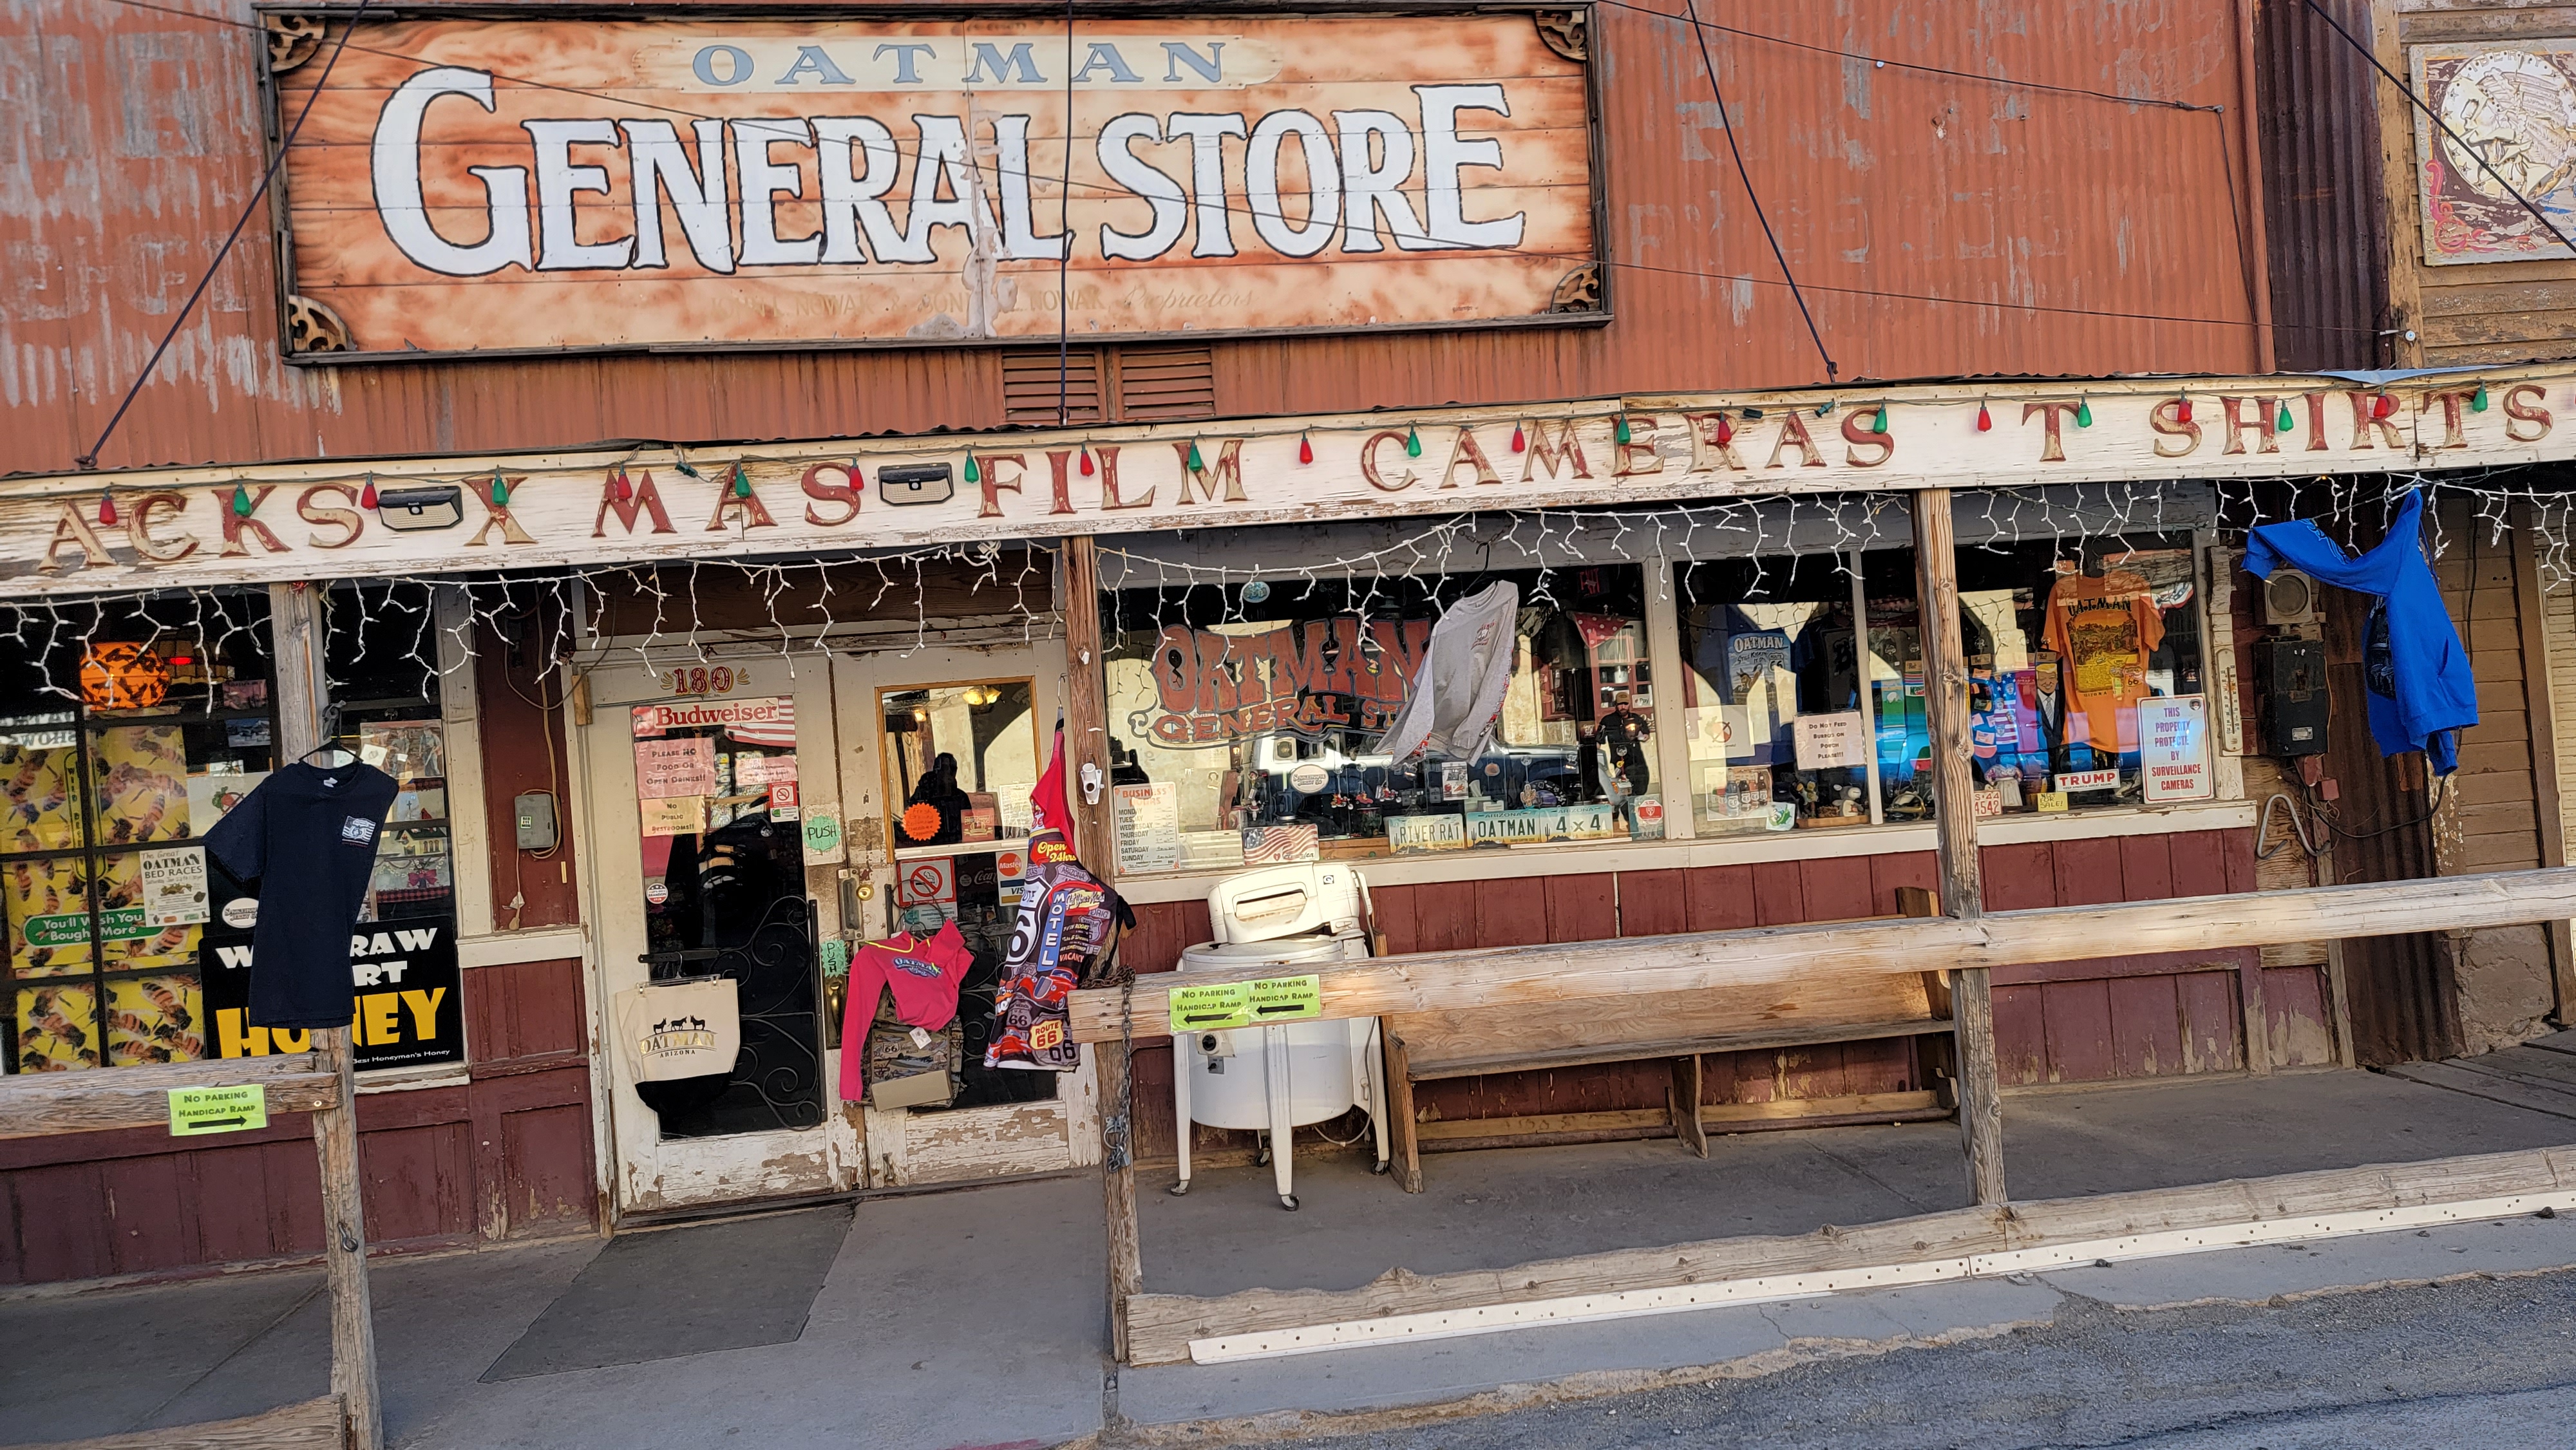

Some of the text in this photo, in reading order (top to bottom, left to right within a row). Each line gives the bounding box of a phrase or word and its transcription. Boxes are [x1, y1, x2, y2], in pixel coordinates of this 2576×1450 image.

[693, 42, 1226, 86] OATMAN
[370, 65, 1526, 276] GENERAL STORE
[39, 384, 2554, 572] ACKS X MAS FILM CAMERAS T SHIRTS
[1734, 636, 1785, 654] OATMAN
[1152, 616, 1432, 712] OATMAN
[674, 666, 734, 695] 180
[654, 702, 778, 727] Budweiser
[2164, 706, 2181, 718] THIS
[1150, 696, 1350, 742] GENERAL
[2170, 750, 2180, 761] BY
[2152, 764, 2201, 777] SURVEILLANCE
[2059, 772, 2116, 787] TRUMP
[2161, 778, 2194, 791] CAMERAS
[1122, 787, 1167, 798] BUSINESS
[1129, 797, 1161, 807] HOURS
[1119, 807, 1142, 816] MONDAY
[1119, 822, 1153, 831] WEDNESDAY
[1478, 818, 1535, 838] OATMAN
[1556, 816, 1567, 833] 4
[1590, 814, 1601, 831] 4
[808, 824, 837, 841] PUSH
[1120, 830, 1149, 839] THURSDAY
[1400, 825, 1435, 843] RIVER
[1037, 841, 1067, 857] Open
[1121, 838, 1139, 847] FRIDAY
[1121, 845, 1150, 854] SATURDAY
[143, 853, 200, 871] OATMAN
[1049, 851, 1077, 863] 24hrs
[1121, 854, 1144, 862] SUNDAY
[144, 865, 203, 879] BED RACES
[43, 912, 142, 930] You'll Wsh You
[50, 926, 137, 941] Bough More
[1041, 892, 1066, 966] MOTEL
[350, 928, 438, 957] RAW
[826, 941, 838, 973] PUSH
[1059, 952, 1085, 963] VACANCY
[1254, 980, 1307, 990] NO PARKING
[1199, 989, 1236, 997] PARKING
[1249, 995, 1289, 1003] HANDICAP
[1177, 1003, 1217, 1012] HANDICAP
[216, 987, 446, 1059] HOEY
[1009, 1015, 1028, 1026] 66
[1035, 1022, 1059, 1035] ROUTE
[640, 1032, 715, 1055] OATMAN
[1036, 1030, 1057, 1048] 66
[372, 1052, 422, 1062] Honeyman's
[660, 1049, 696, 1059] ARIZONA
[184, 1091, 249, 1104] NO PARKING
[178, 1105, 256, 1118] HANDICAP RAMP
